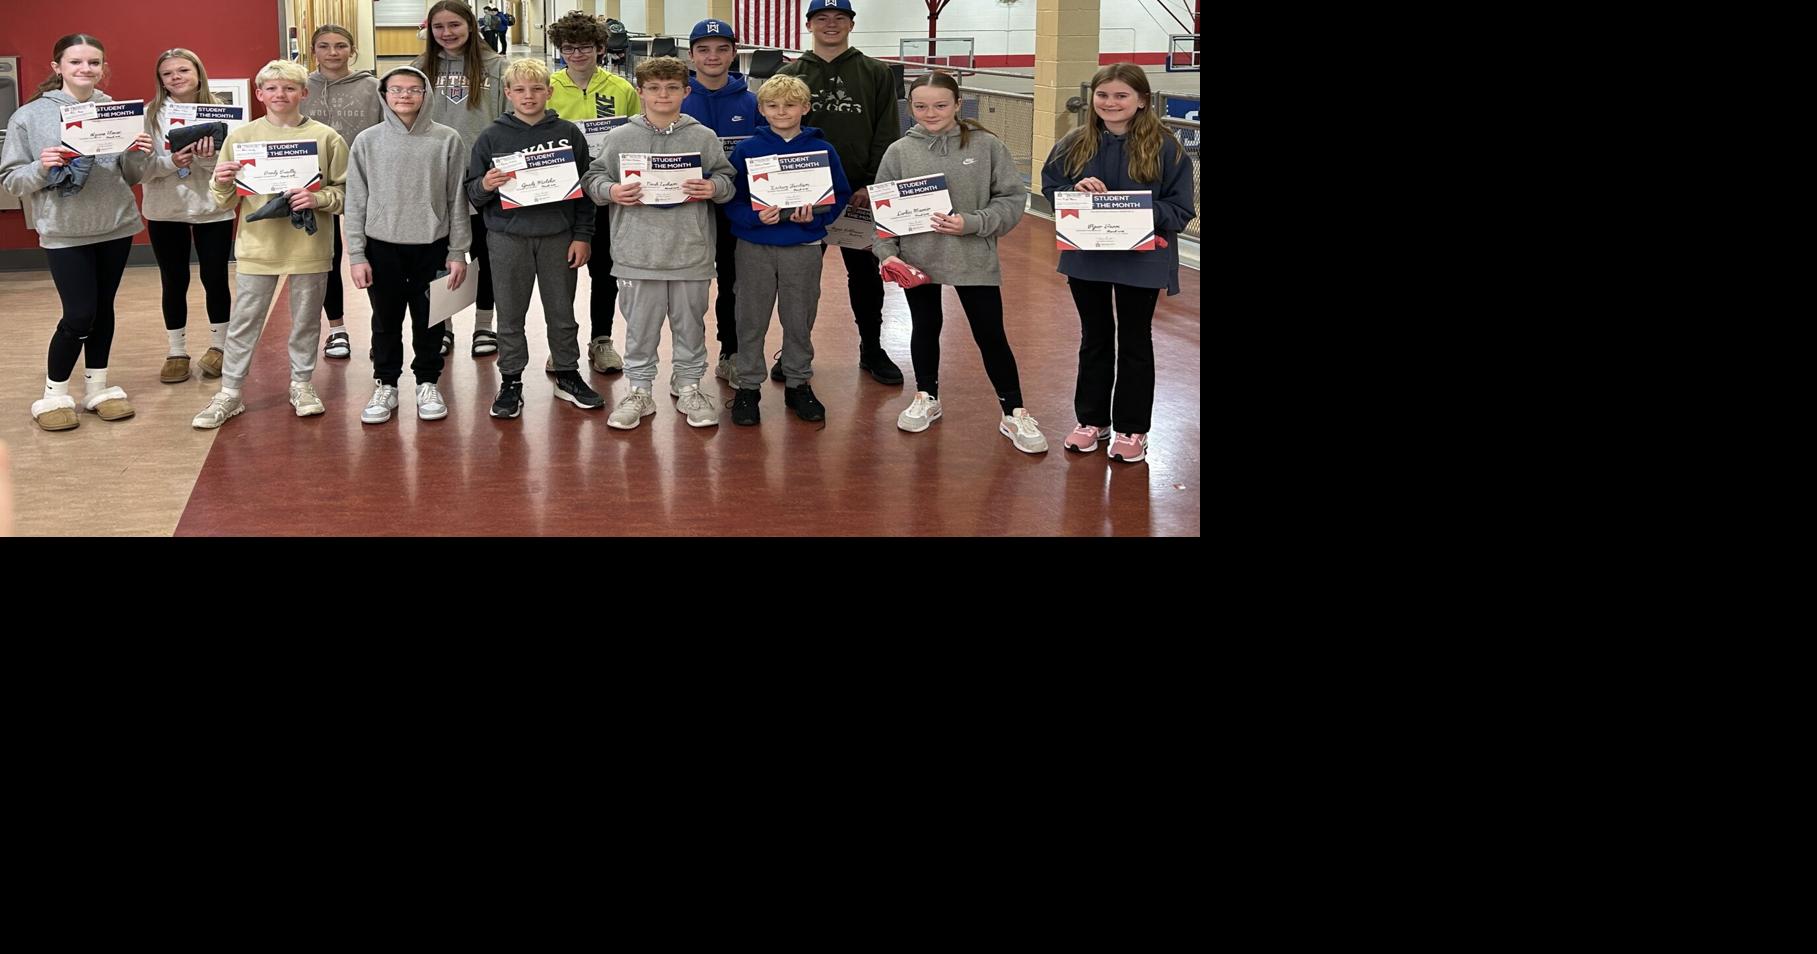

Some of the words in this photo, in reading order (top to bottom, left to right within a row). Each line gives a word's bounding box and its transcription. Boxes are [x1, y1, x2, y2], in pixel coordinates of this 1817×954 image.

[526, 153, 555, 162] STUDENT
[898, 180, 928, 189] STUDENT
[914, 185, 938, 193] MONTH
